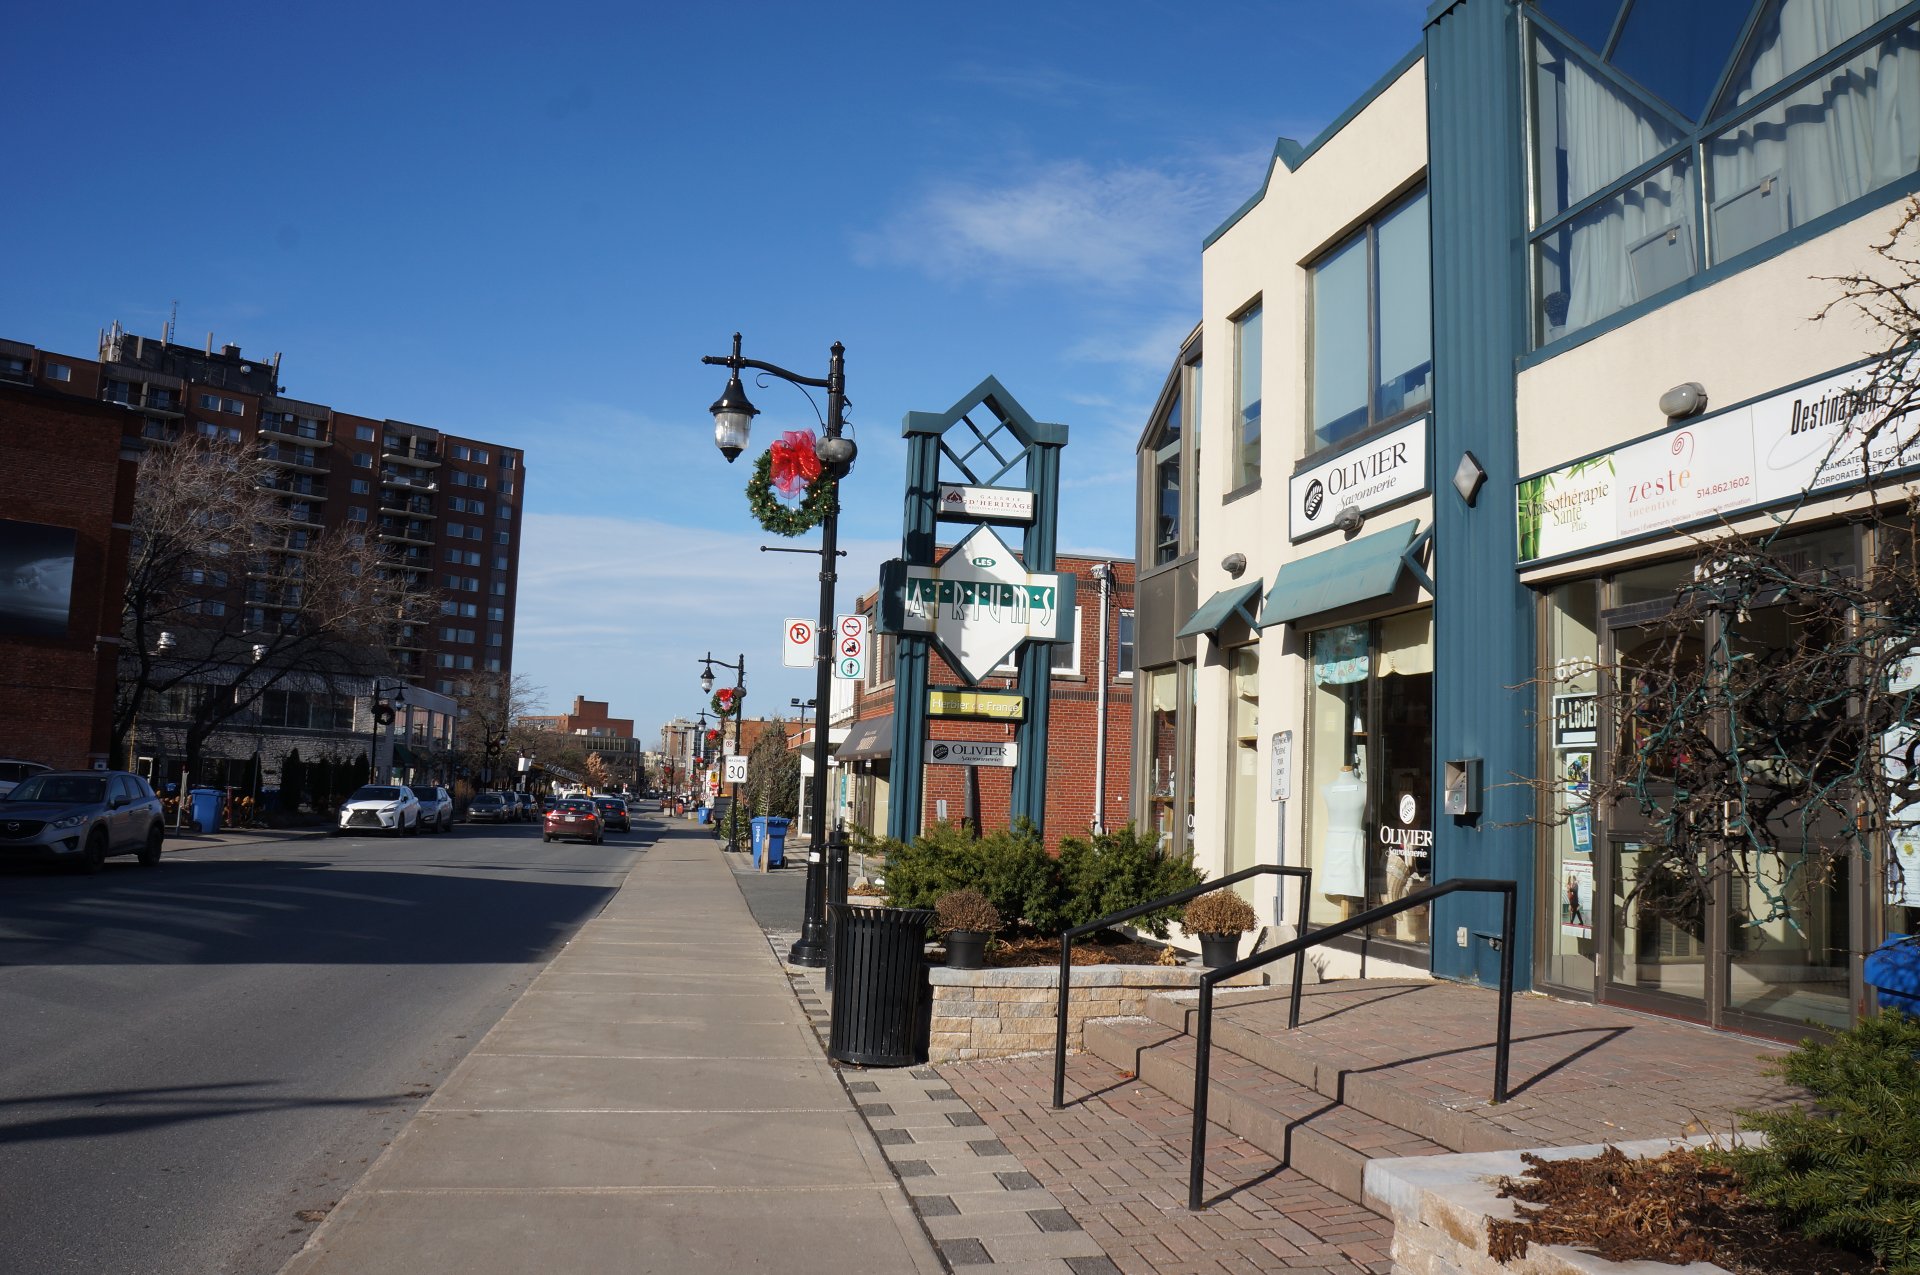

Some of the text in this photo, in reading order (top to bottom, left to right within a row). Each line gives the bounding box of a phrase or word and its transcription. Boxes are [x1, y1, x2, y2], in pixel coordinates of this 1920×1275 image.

[1872, 448, 1883, 458] DE
[1328, 442, 1408, 495] OLIVIER
[1815, 468, 1859, 486] CORPORATE
[1336, 476, 1397, 512] Savonnerie
[1628, 468, 1691, 504] zeste
[1697, 476, 1750, 499] 514.862.1602
[1525, 481, 1609, 518] Massothérapie
[1553, 504, 1582, 527] Santé
[1571, 520, 1588, 533] Plus
[975, 559, 993, 567] LES
[1557, 656, 1593, 680] 680
[932, 698, 968, 710] Herbier
[987, 701, 1018, 712] France
[1559, 699, 1566, 729] À
[952, 744, 1008, 756] OLIVIER
[728, 765, 745, 779] 30
[1380, 825, 1432, 847] OLIVIER
